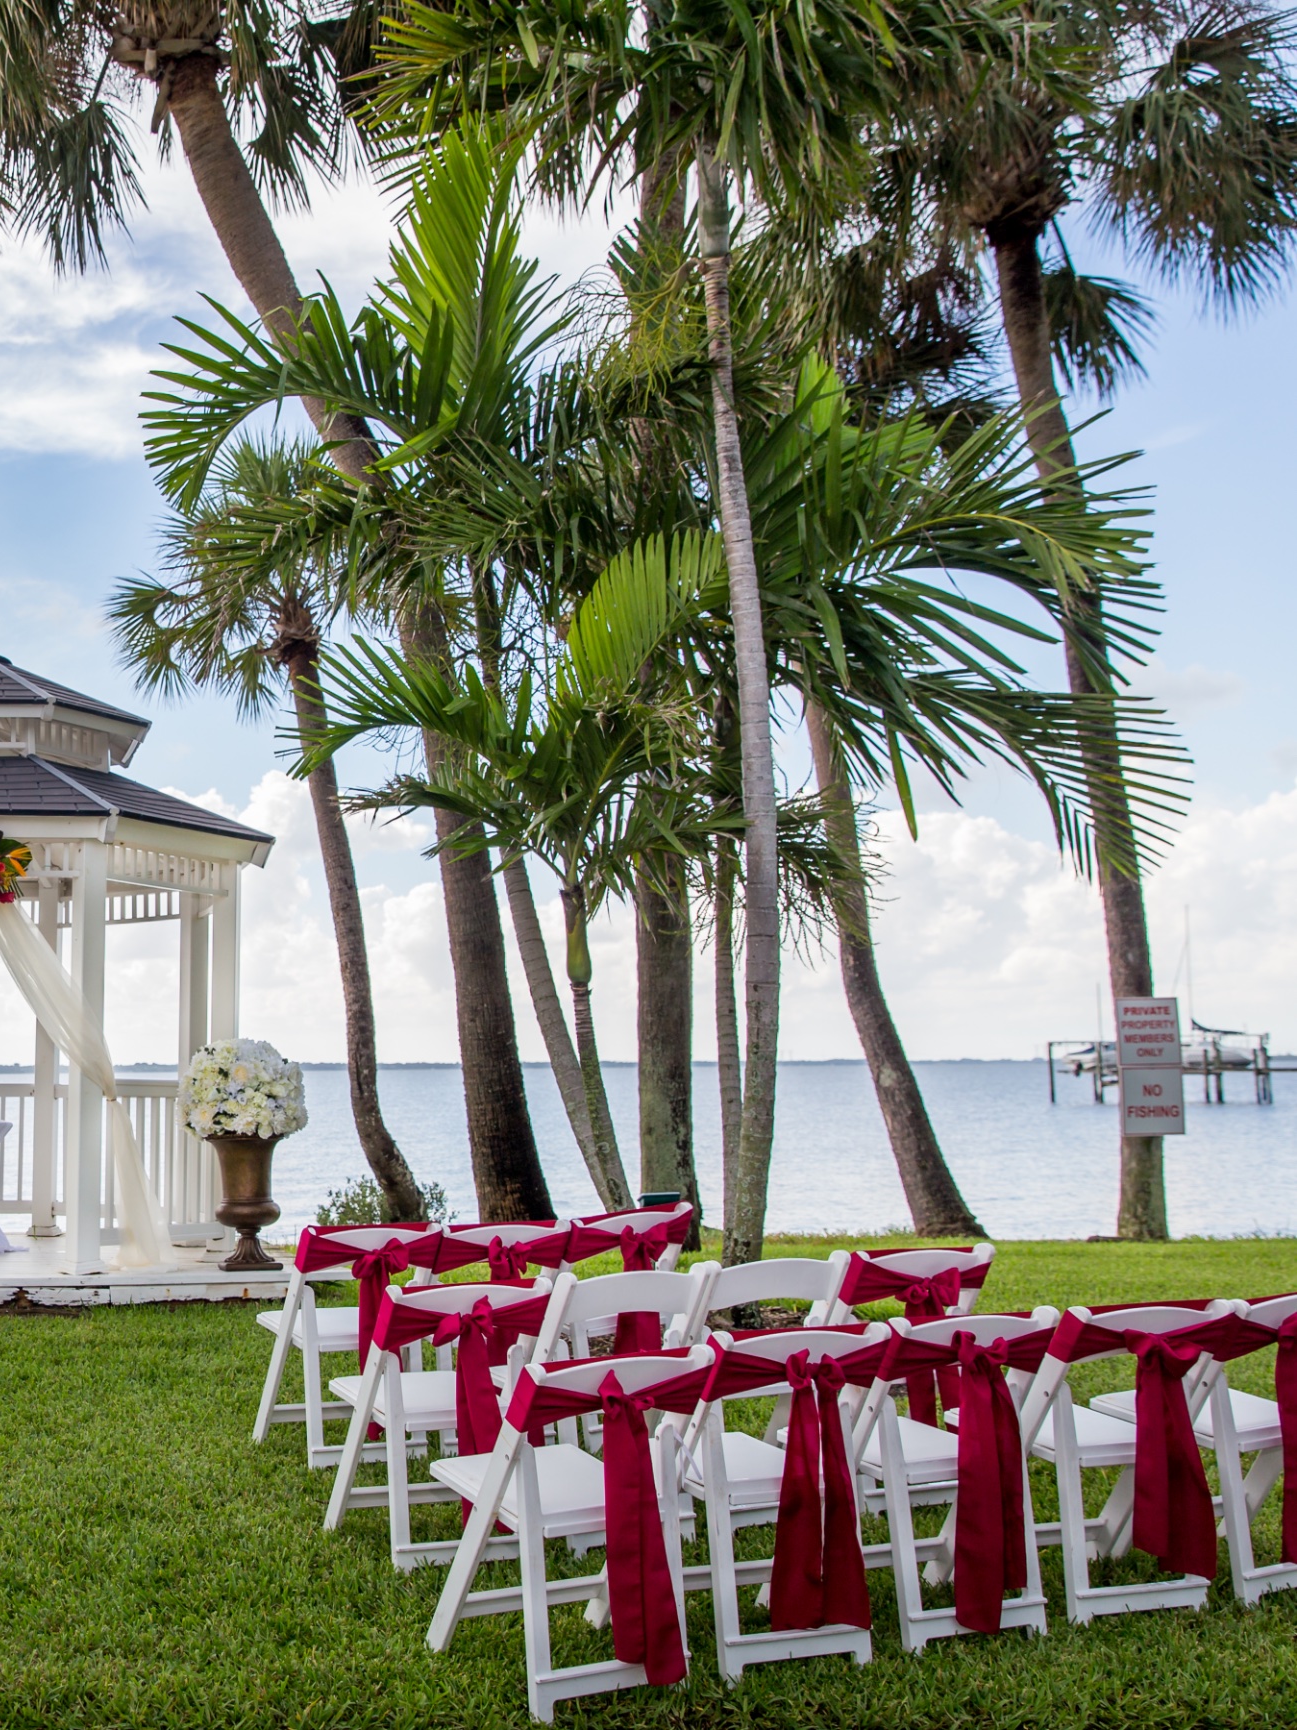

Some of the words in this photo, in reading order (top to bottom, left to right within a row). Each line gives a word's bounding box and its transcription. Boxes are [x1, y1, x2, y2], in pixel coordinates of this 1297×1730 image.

[1123, 1006, 1171, 1016] PRIVATE
[1120, 1019, 1176, 1029] PROPERTY
[1124, 1033, 1175, 1043] MEMBERS
[1136, 1047, 1164, 1057] ONLY
[1142, 1084, 1162, 1096] NO
[1127, 1105, 1180, 1118] FISHING
